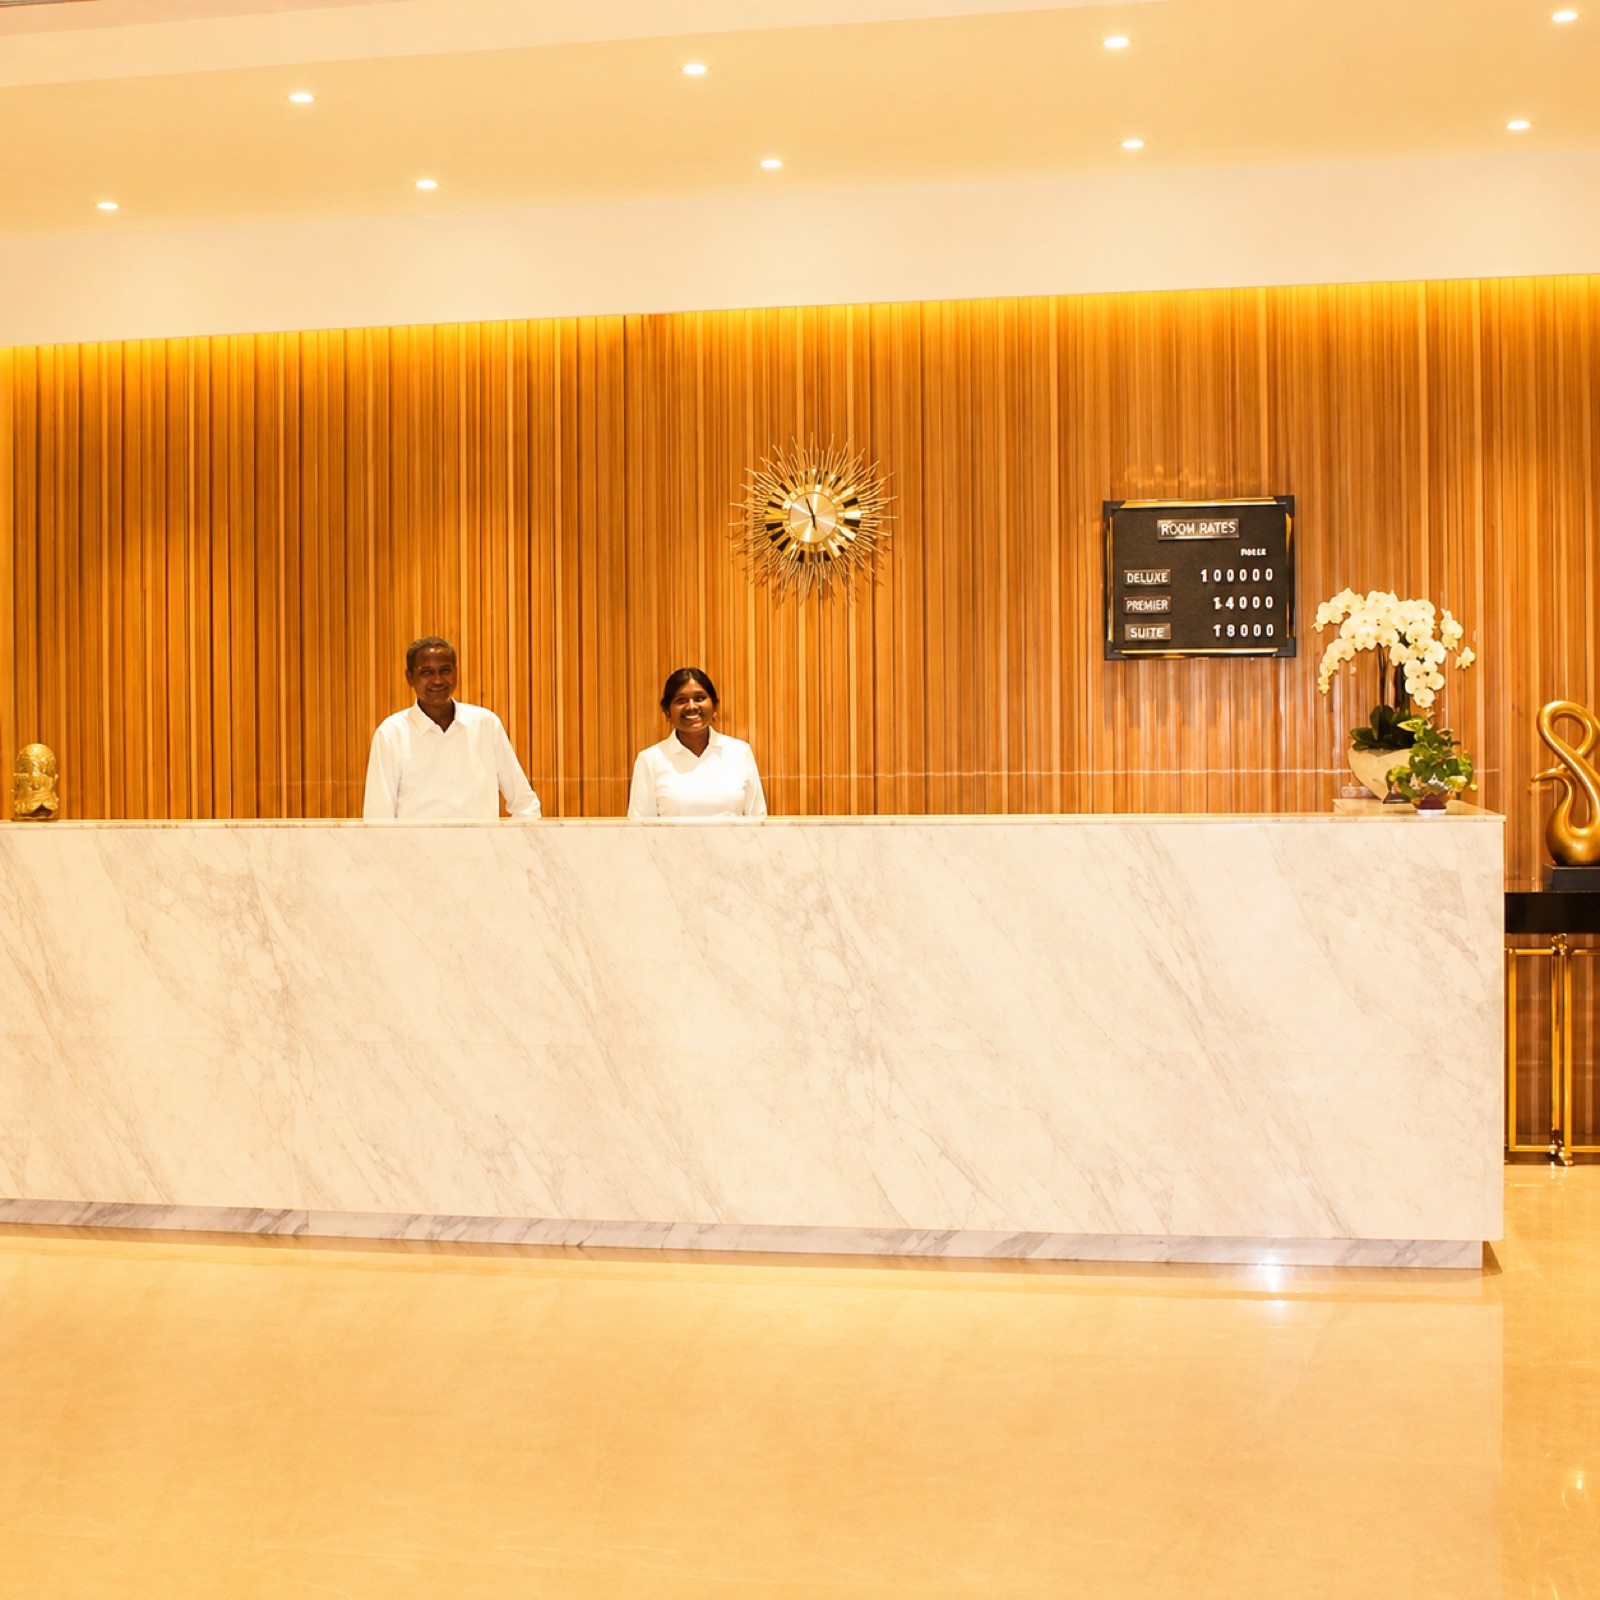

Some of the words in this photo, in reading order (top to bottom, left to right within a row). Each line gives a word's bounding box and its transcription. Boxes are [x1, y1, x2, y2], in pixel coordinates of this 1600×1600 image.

[1161, 523, 1195, 536] ROOM
[1199, 522, 1236, 534] RATES
[1126, 572, 1168, 584] DELUXE
[1126, 599, 1168, 611] PREMIER
[1130, 627, 1165, 639] SUITE
[1212, 624, 1274, 638] 18000
